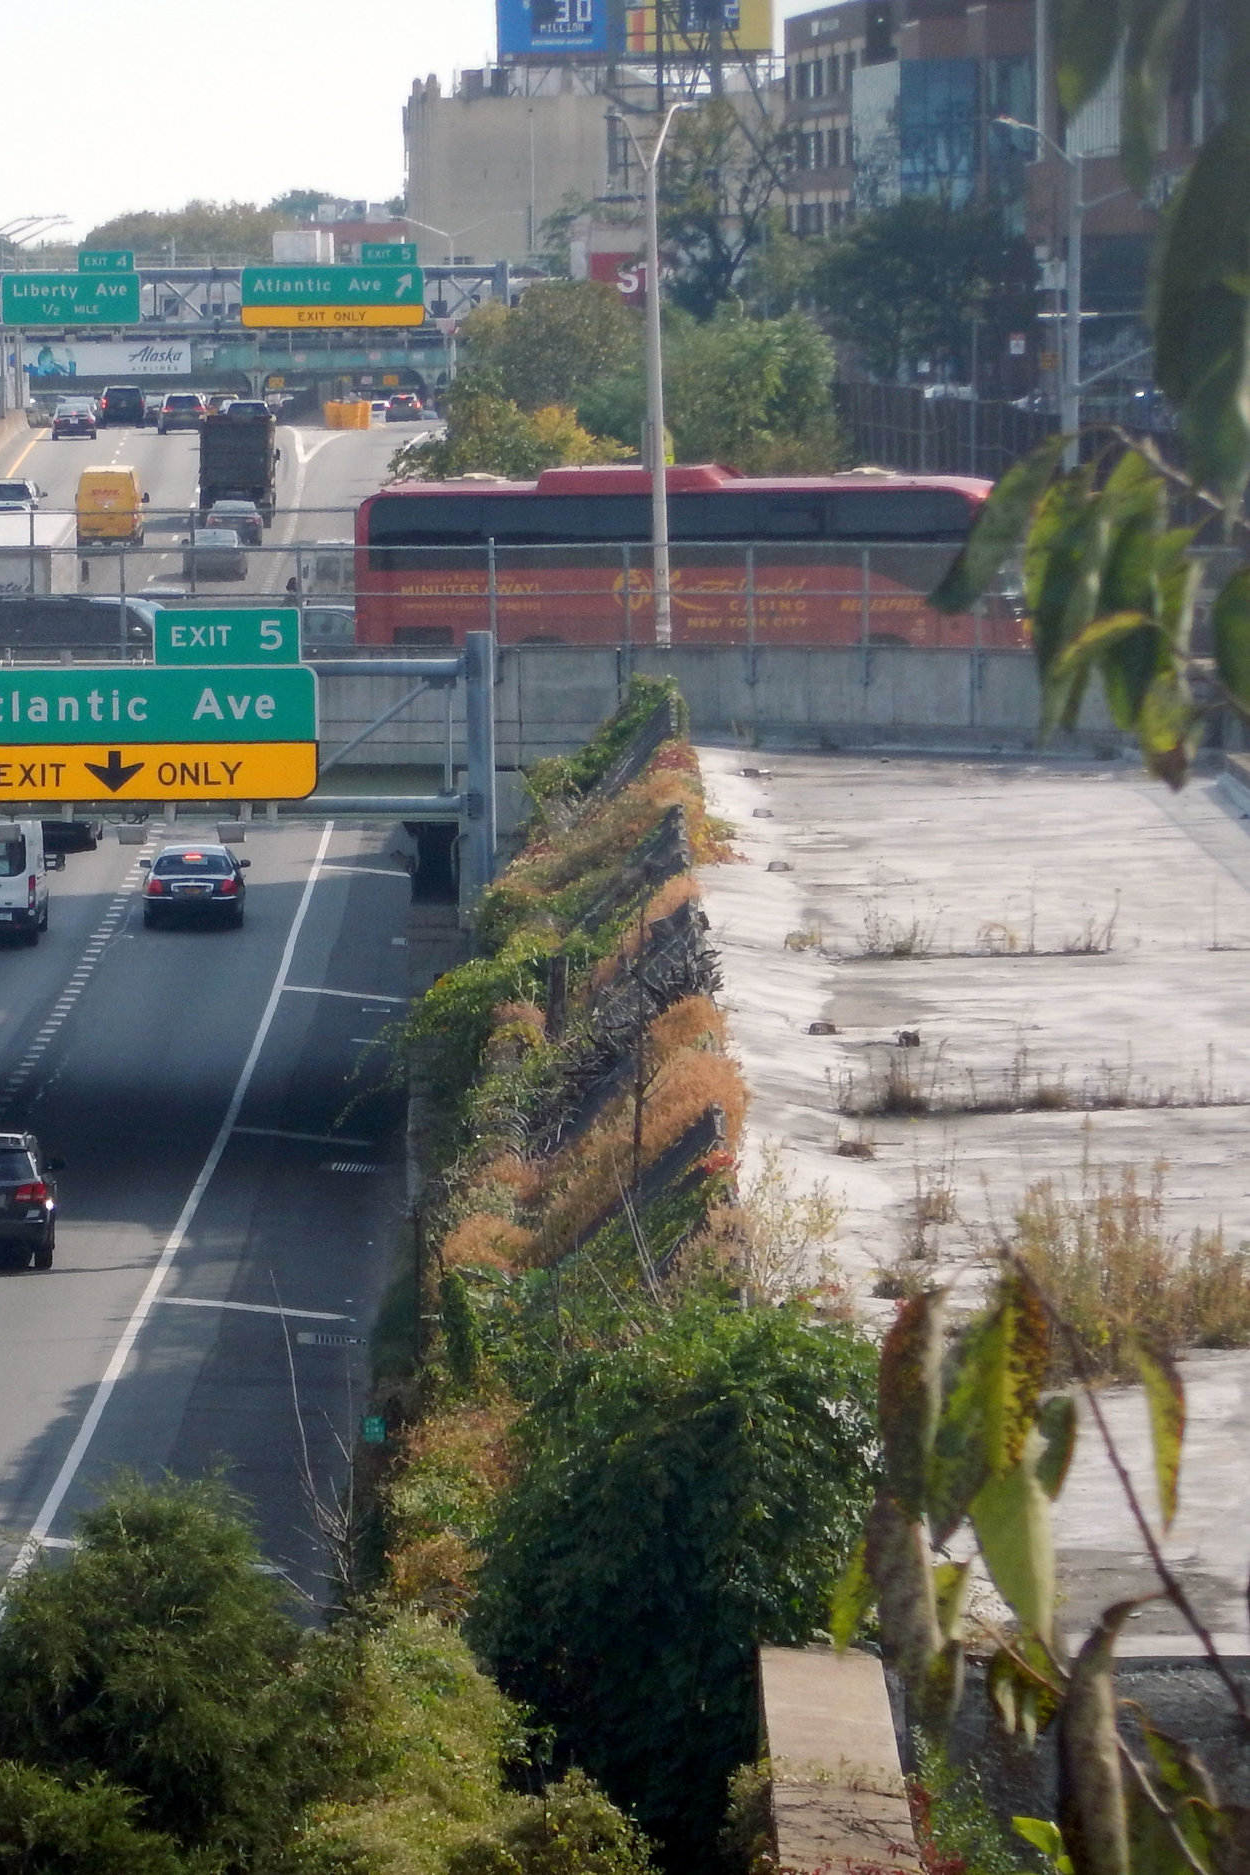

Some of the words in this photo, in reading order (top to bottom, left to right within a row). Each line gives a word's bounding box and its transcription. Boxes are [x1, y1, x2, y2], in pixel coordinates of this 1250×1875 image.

[540, 22, 584, 33] MILLION
[367, 249, 390, 258] EXIT
[402, 248, 411, 260] 5
[84, 257, 107, 267] EXIT
[116, 255, 127, 267] 4
[13, 283, 78, 299] Liberty
[96, 283, 128, 296] Ave
[253, 279, 331, 292] Atlantic
[348, 278, 382, 291] Ave
[74, 305, 100, 314] MILE
[297, 311, 326, 321] EXIT
[333, 311, 366, 321] ONLY
[128, 346, 183, 363] Alaska
[687, 617, 722, 628] NEW
[773, 617, 807, 627] CITY
[171, 626, 231, 647] EXIT
[260, 620, 283, 650] 5
[193, 688, 276, 720] Ave
[157, 761, 242, 786] ONLY
